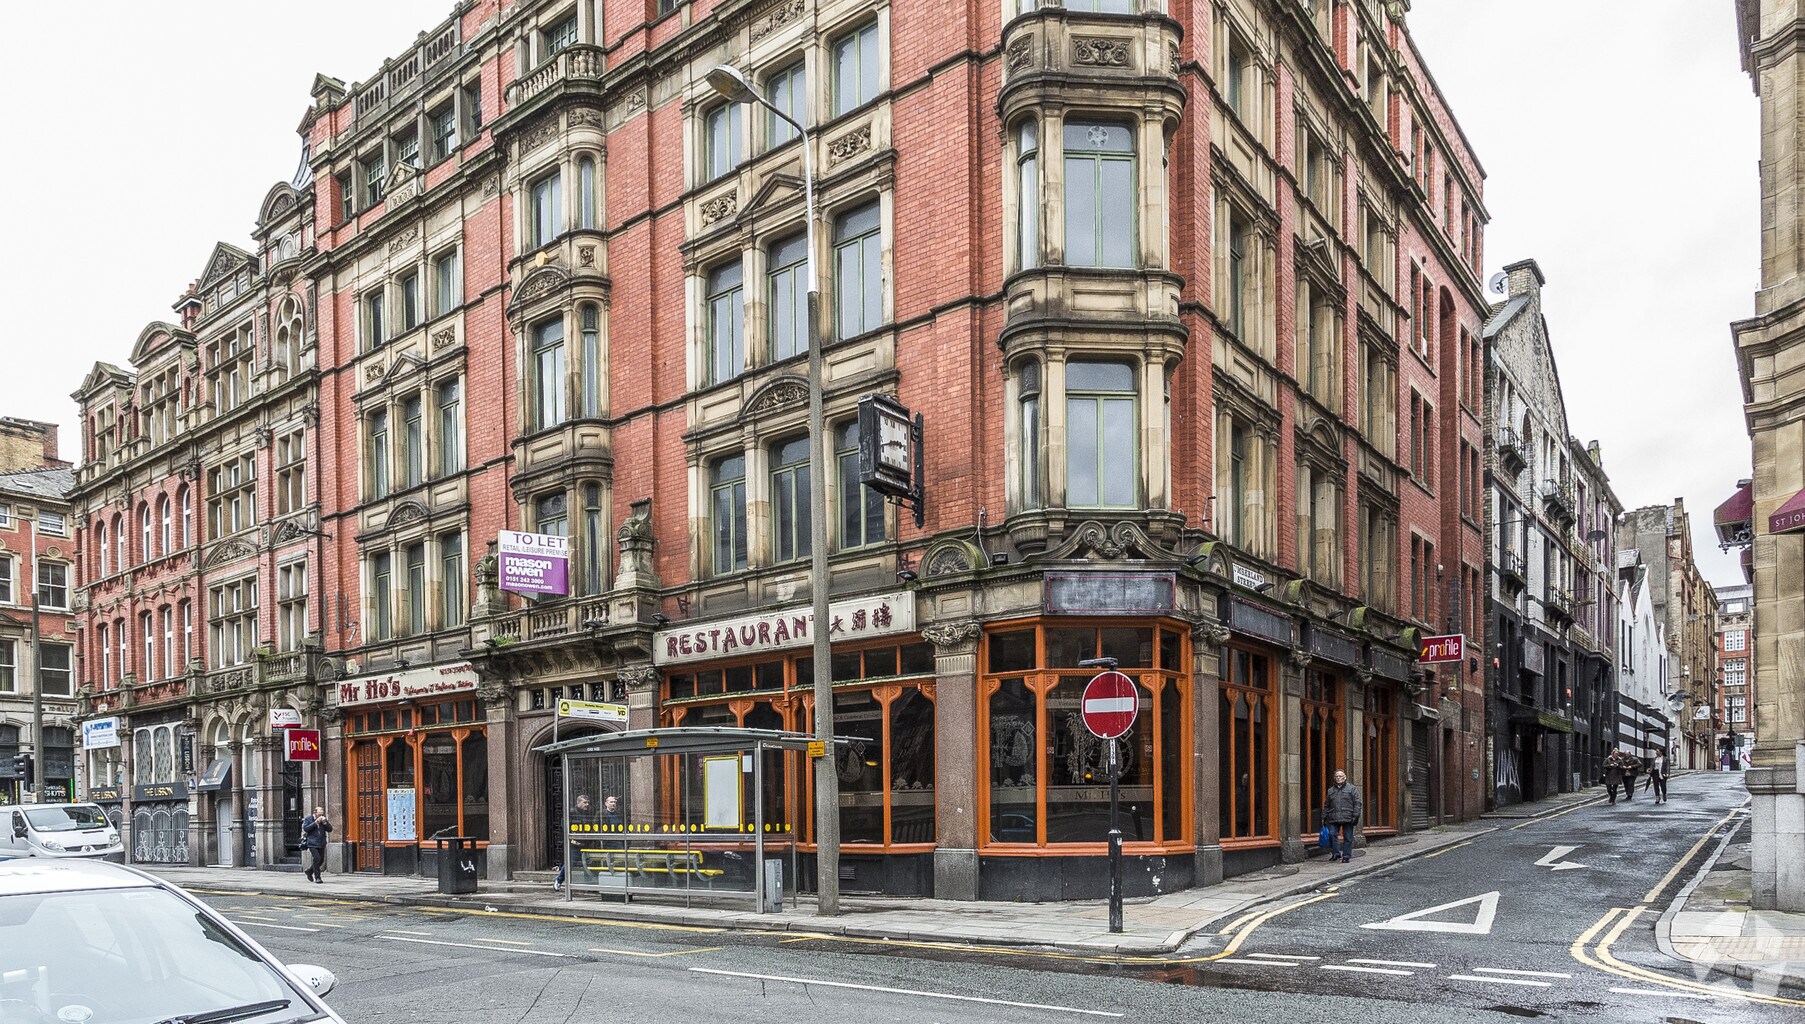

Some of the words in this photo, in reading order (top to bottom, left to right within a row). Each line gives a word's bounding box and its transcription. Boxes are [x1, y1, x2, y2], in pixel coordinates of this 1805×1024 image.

[1775, 517, 1786, 527] ST
[513, 533, 533, 545] TO
[538, 536, 566, 548] LET
[505, 556, 553, 570] mason
[505, 565, 544, 578] owen
[505, 581, 553, 590] masonowen.com
[1429, 638, 1459, 661] profile
[340, 682, 360, 704] Mr
[365, 676, 401, 700] Ho's
[290, 737, 312, 754] profile
[92, 791, 100, 799] THE
[101, 790, 118, 799] LISBON
[143, 788, 154, 796] THE
[155, 786, 174, 796] LISBON
